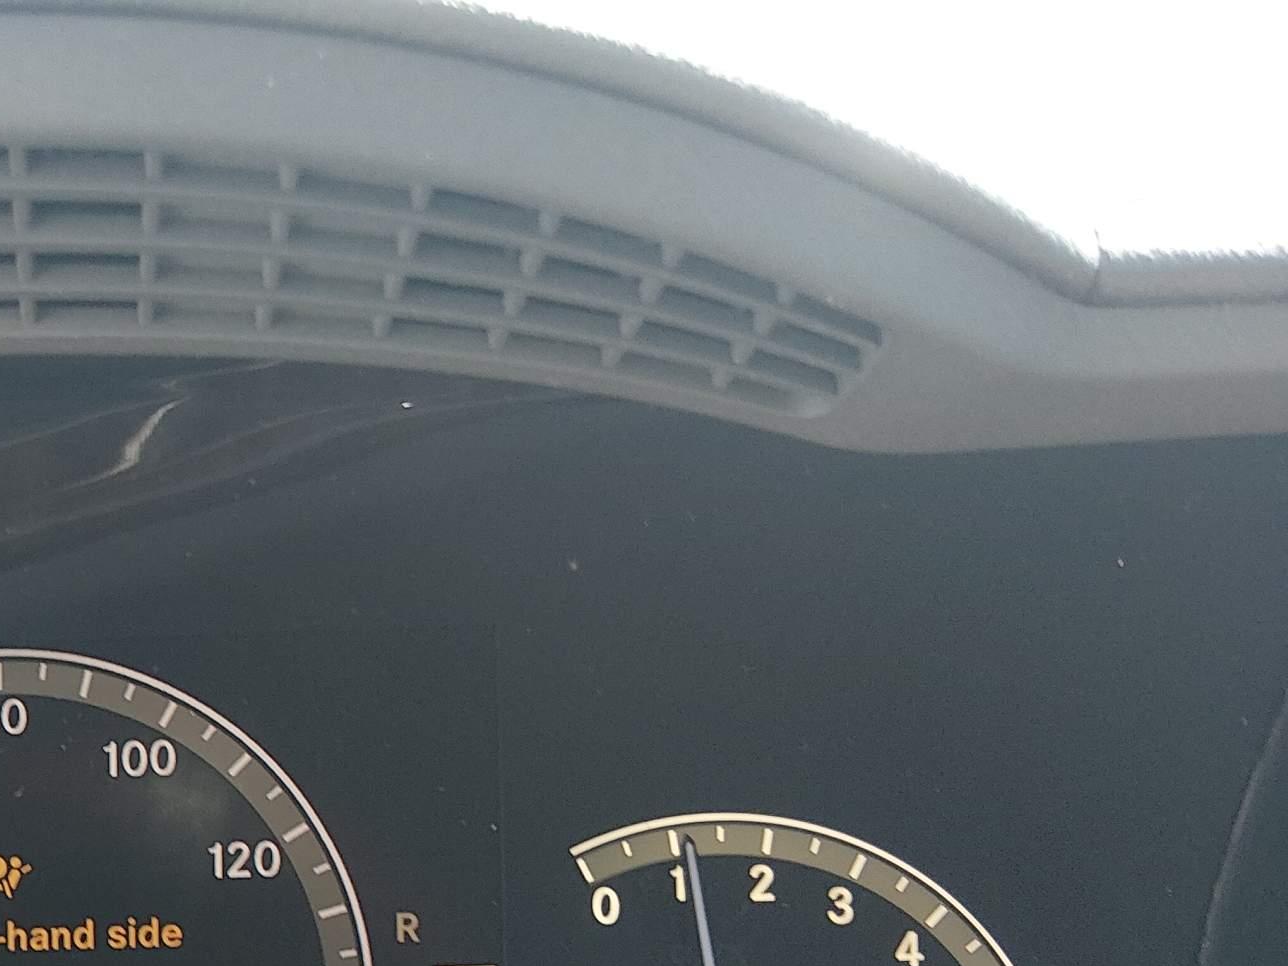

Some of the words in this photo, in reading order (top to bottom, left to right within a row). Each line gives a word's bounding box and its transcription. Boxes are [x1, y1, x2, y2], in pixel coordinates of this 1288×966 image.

[102, 739, 177, 778] 100
[207, 840, 281, 879] 120
[668, 864, 688, 904] 1
[749, 863, 776, 902] 2
[592, 886, 620, 925] 0
[827, 886, 854, 925] 3
[107, 916, 183, 949] side
[396, 912, 420, 943] R
